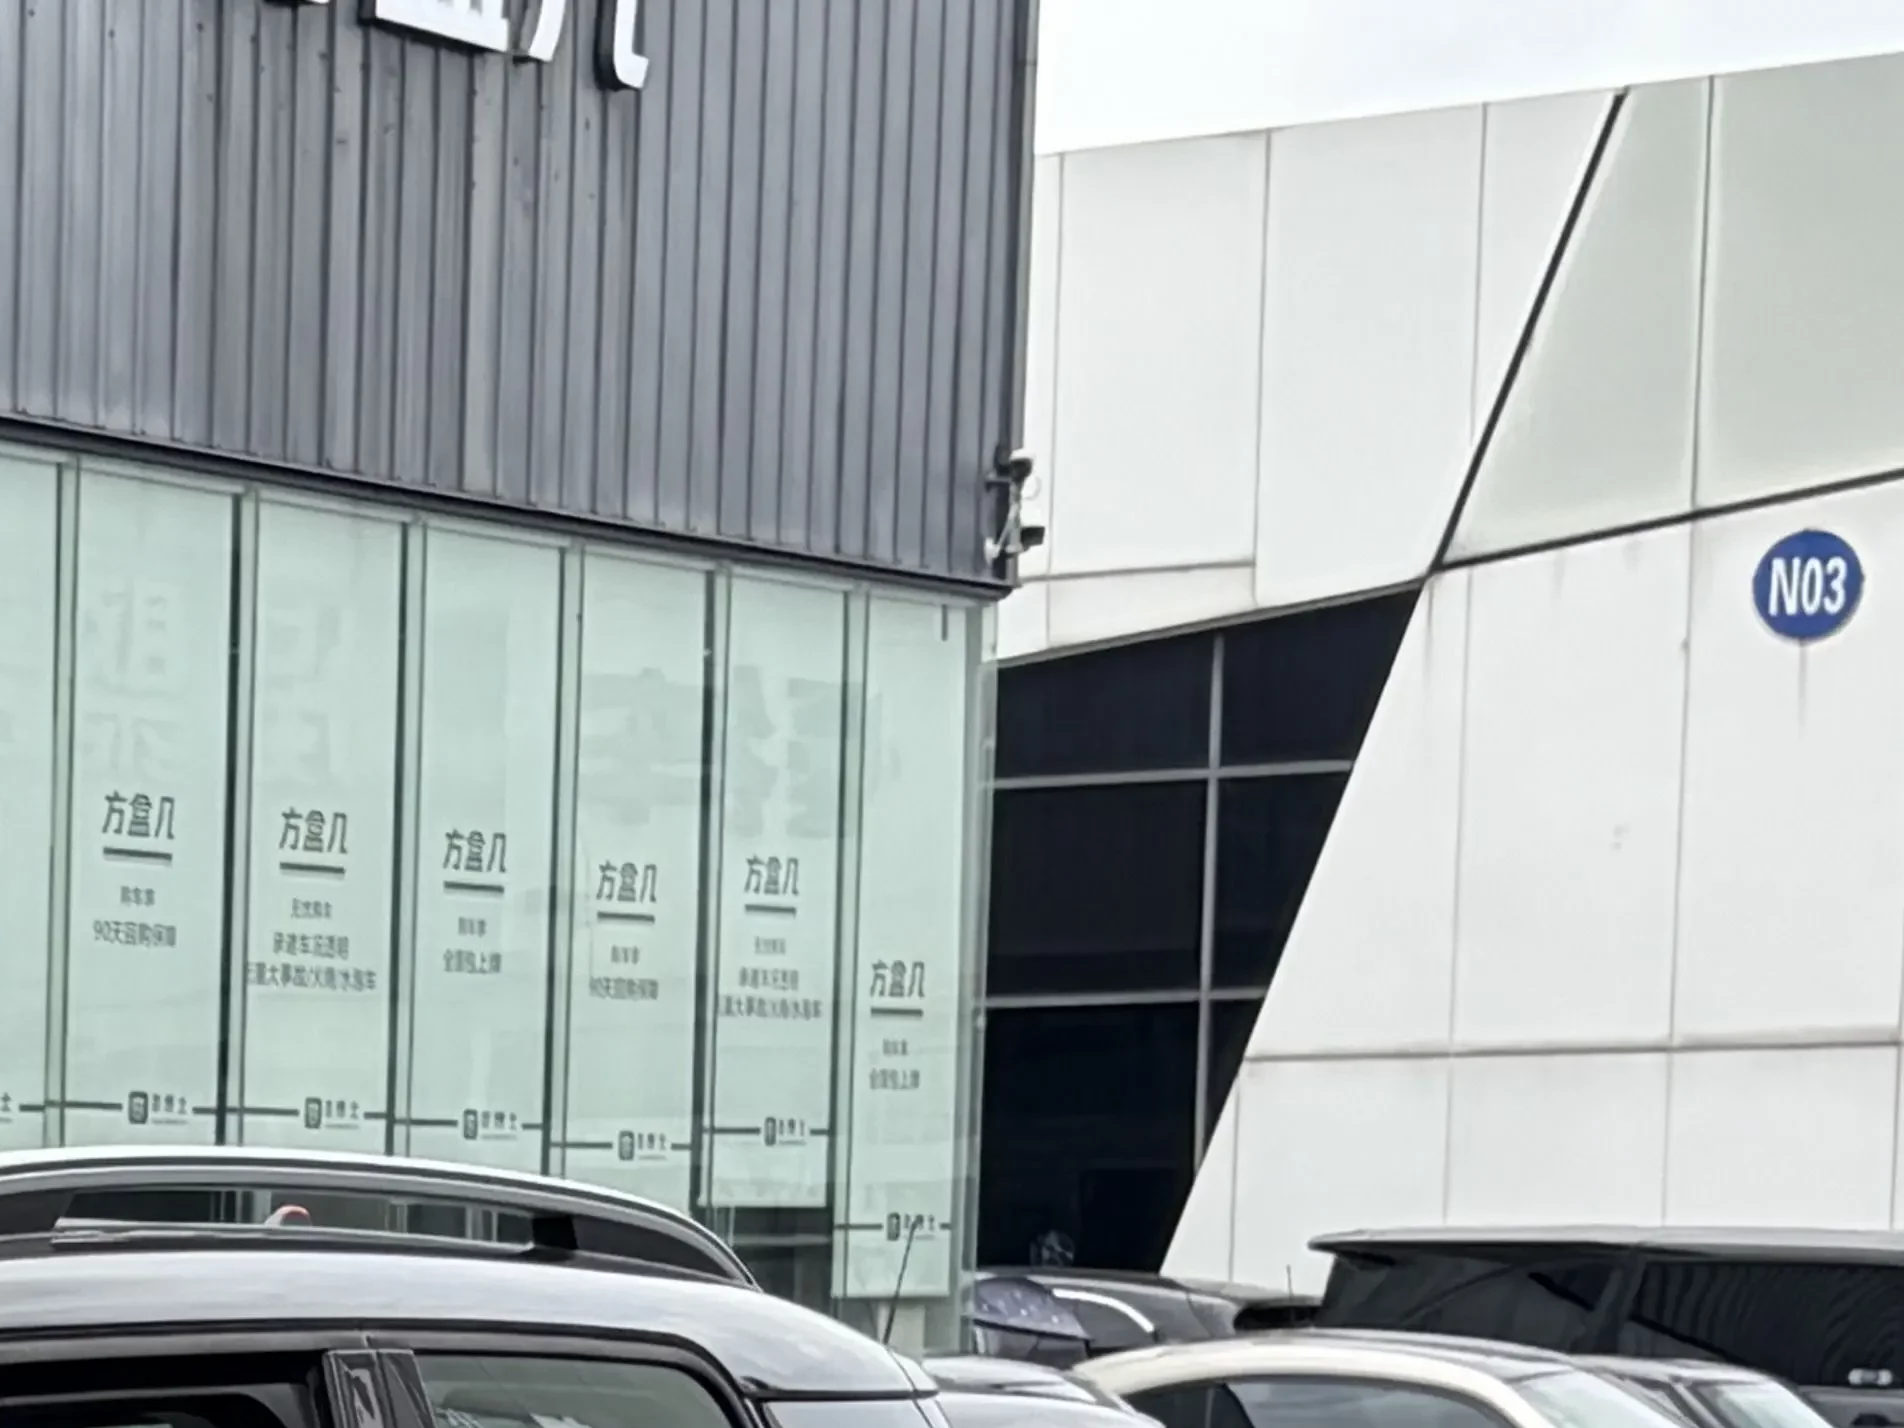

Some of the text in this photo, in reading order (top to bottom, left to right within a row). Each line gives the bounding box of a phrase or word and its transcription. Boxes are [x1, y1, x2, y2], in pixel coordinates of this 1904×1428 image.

[1768, 556, 1848, 616] N03
[101, 790, 176, 841] 方盒几
